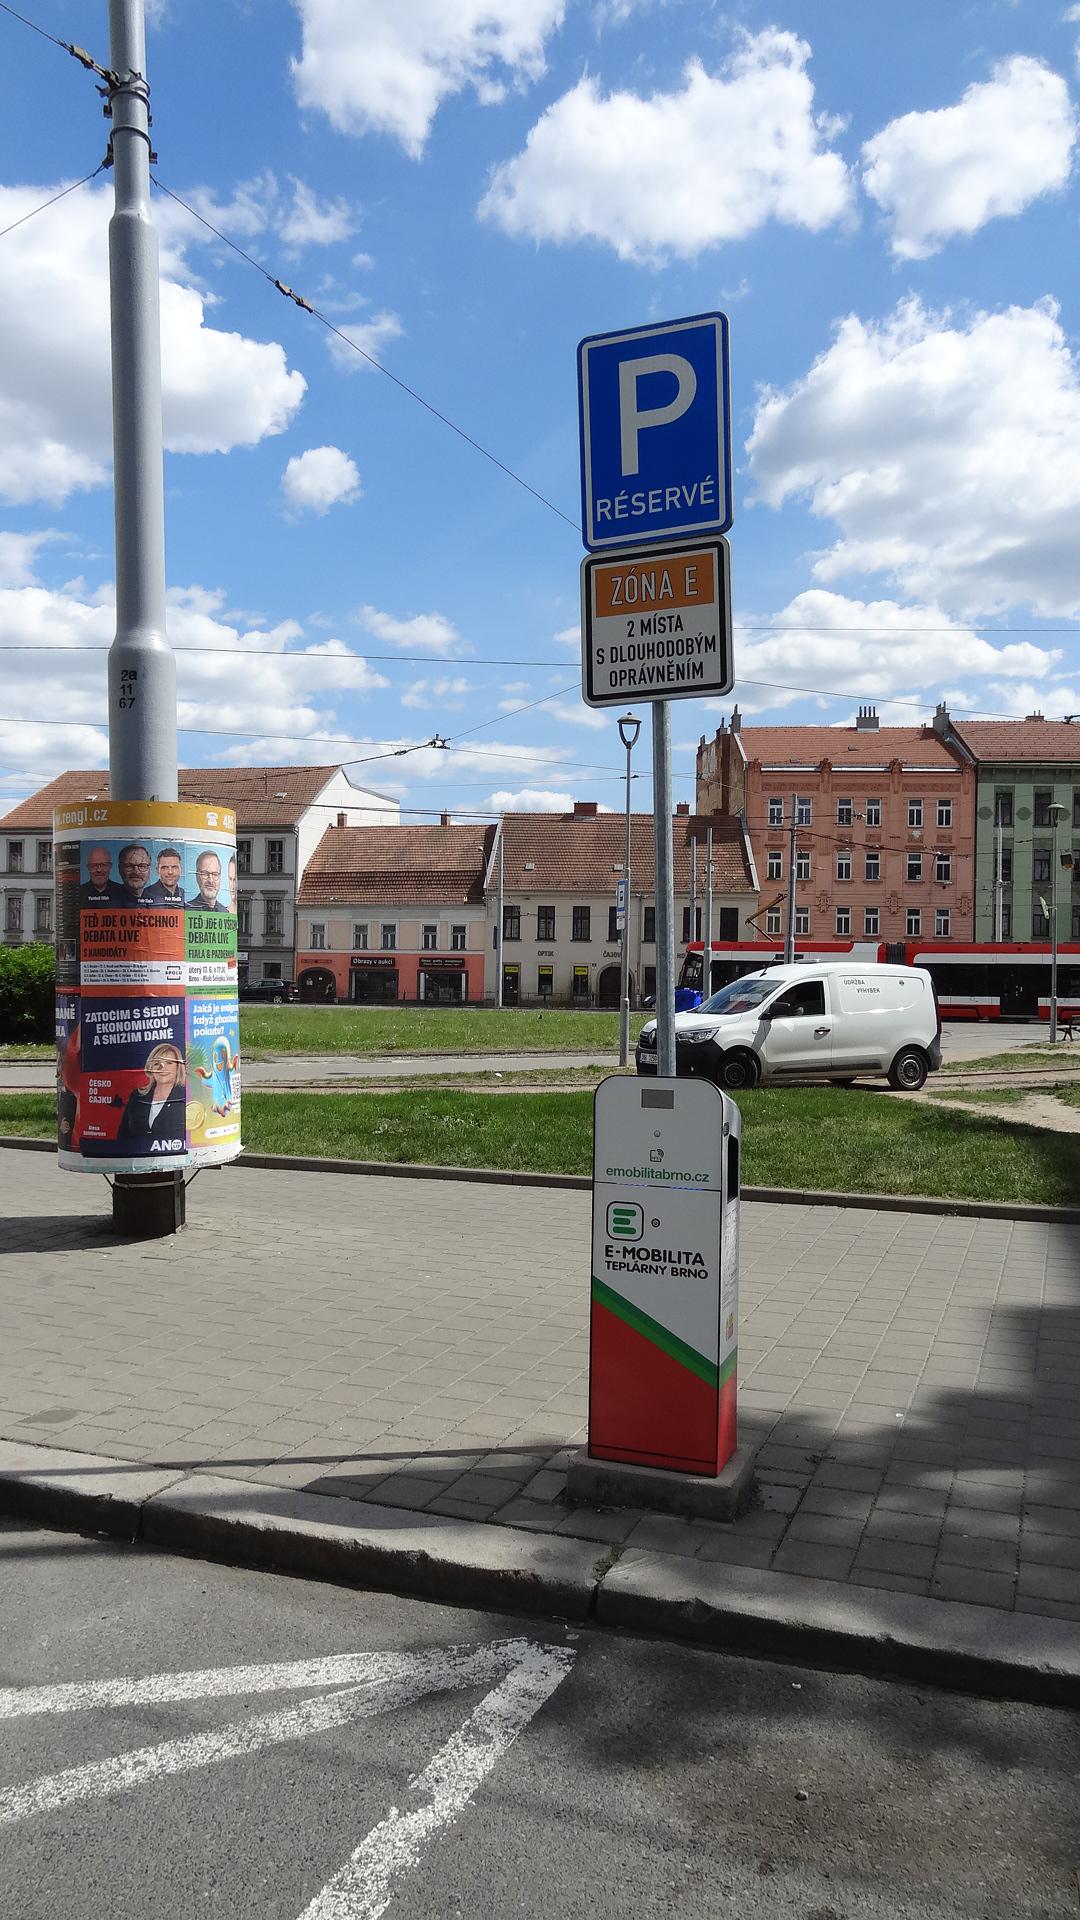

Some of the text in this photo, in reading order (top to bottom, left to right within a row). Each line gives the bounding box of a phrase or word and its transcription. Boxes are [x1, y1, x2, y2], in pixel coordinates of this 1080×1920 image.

[618, 353, 697, 477] P
[596, 476, 715, 522] RÉSERVÉ
[611, 565, 698, 606] ZÓNA E
[626, 613, 684, 638] 2 MÍSTA
[596, 633, 717, 665] S DLOUHODOBÝM
[121, 670, 137, 681] 2a
[609, 660, 704, 688] OPRÁVNĚNÍM
[121, 683, 133, 695] 11
[119, 697, 136, 709] 67
[83, 913, 178, 928] TEĎ JDE O VŠECHNO!
[188, 915, 203, 929] TEĎ
[206, 918, 217, 930] JDE
[83, 930, 139, 942] DEBATA LIVE
[188, 932, 228, 944] DEBATA LIVE
[353, 958, 373, 966] Obrazy
[85, 1005, 179, 1022] ZATOČÍM S ŠEDOU
[193, 1003, 212, 1013] Jaká
[213, 1004, 219, 1014] je
[96, 1018, 168, 1033] EKONOMIKOU
[194, 1015, 213, 1026] když
[94, 1036, 100, 1045] A
[89, 1079, 111, 1087] ČESKO
[606, 1166, 710, 1182] emobilitabrno.cz
[605, 1245, 705, 1266] E-MOBILITA
[605, 1260, 708, 1279] TEPLÁRNY BRNO
